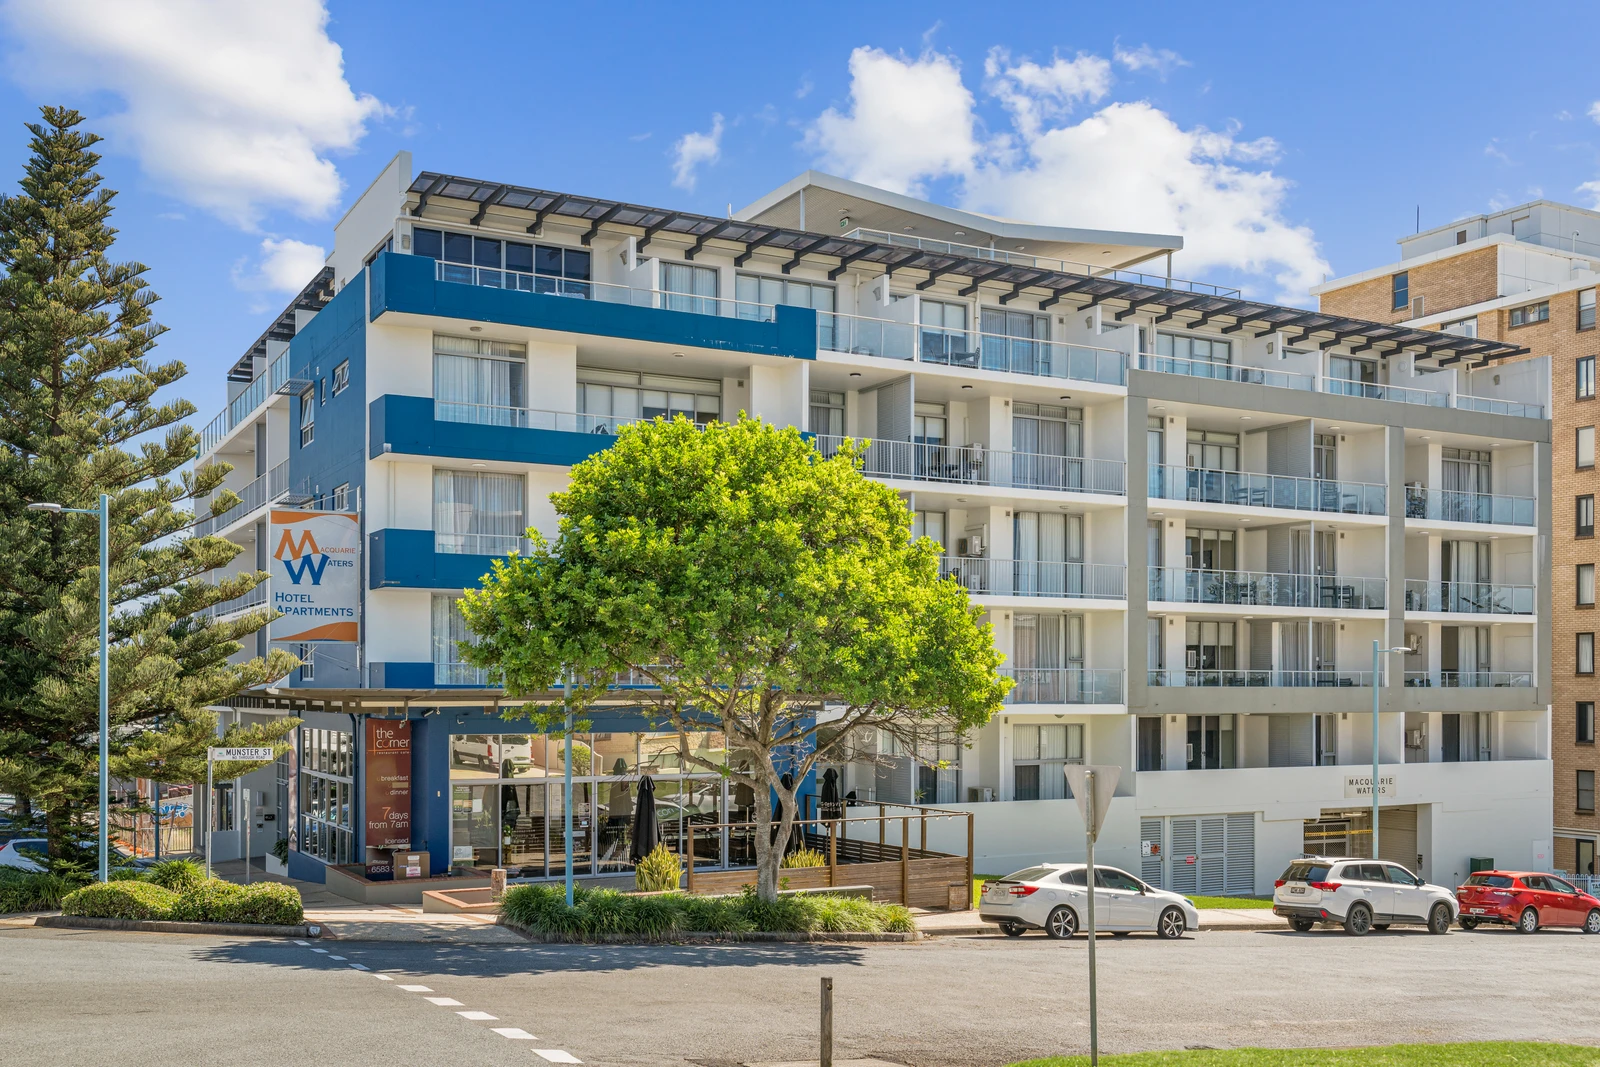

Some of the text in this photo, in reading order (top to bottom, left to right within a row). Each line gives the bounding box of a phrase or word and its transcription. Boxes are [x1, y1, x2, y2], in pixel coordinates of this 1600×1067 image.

[275, 592, 314, 603] HOTEL
[276, 605, 353, 617] APARTMENTS
[376, 727, 394, 739] the
[376, 738, 410, 748] corner
[368, 820, 408, 829] from 7am
